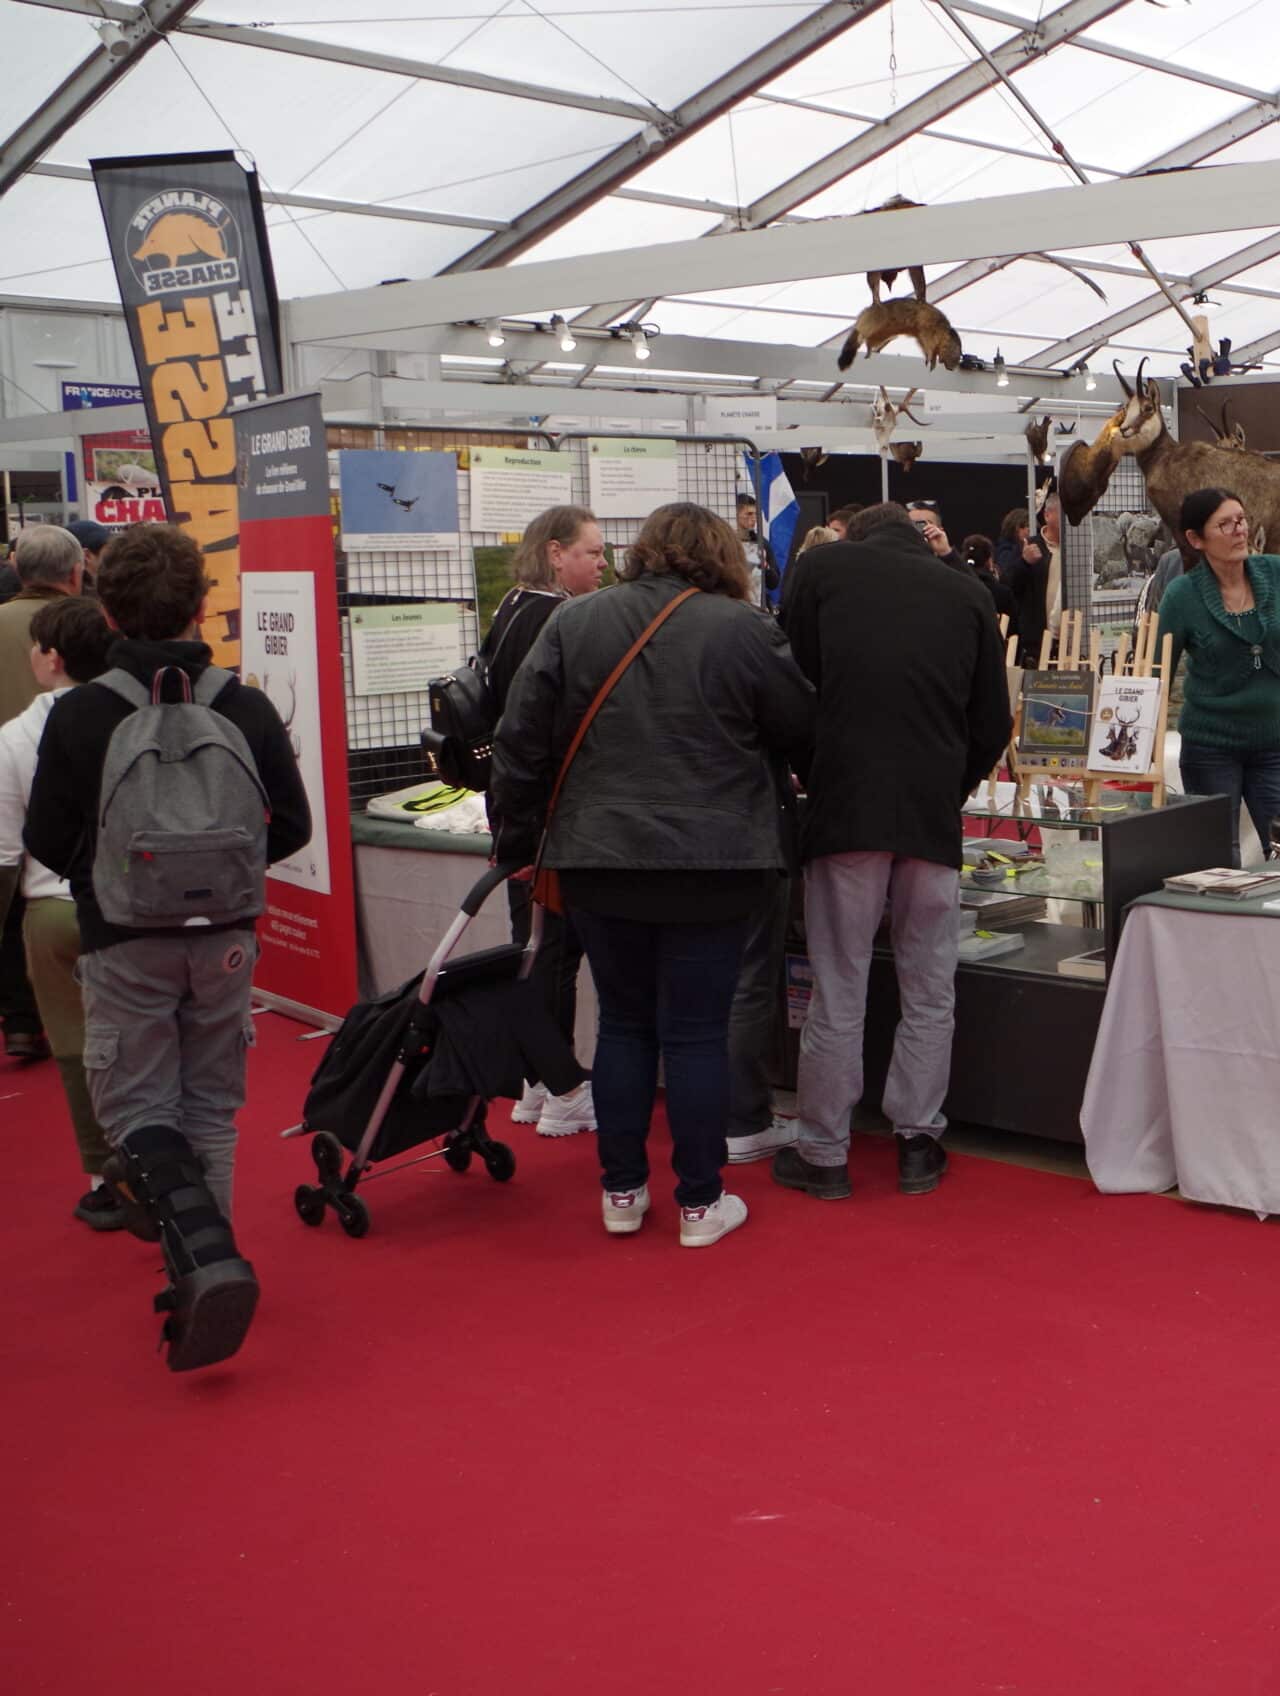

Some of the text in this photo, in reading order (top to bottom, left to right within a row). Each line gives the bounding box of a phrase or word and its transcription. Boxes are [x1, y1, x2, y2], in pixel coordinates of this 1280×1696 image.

[251, 425, 311, 455] LE GRAND GIBIER
[95, 499, 165, 523] CHA
[257, 611, 294, 632] LE GRAND
[265, 635, 288, 656] GIBIER
